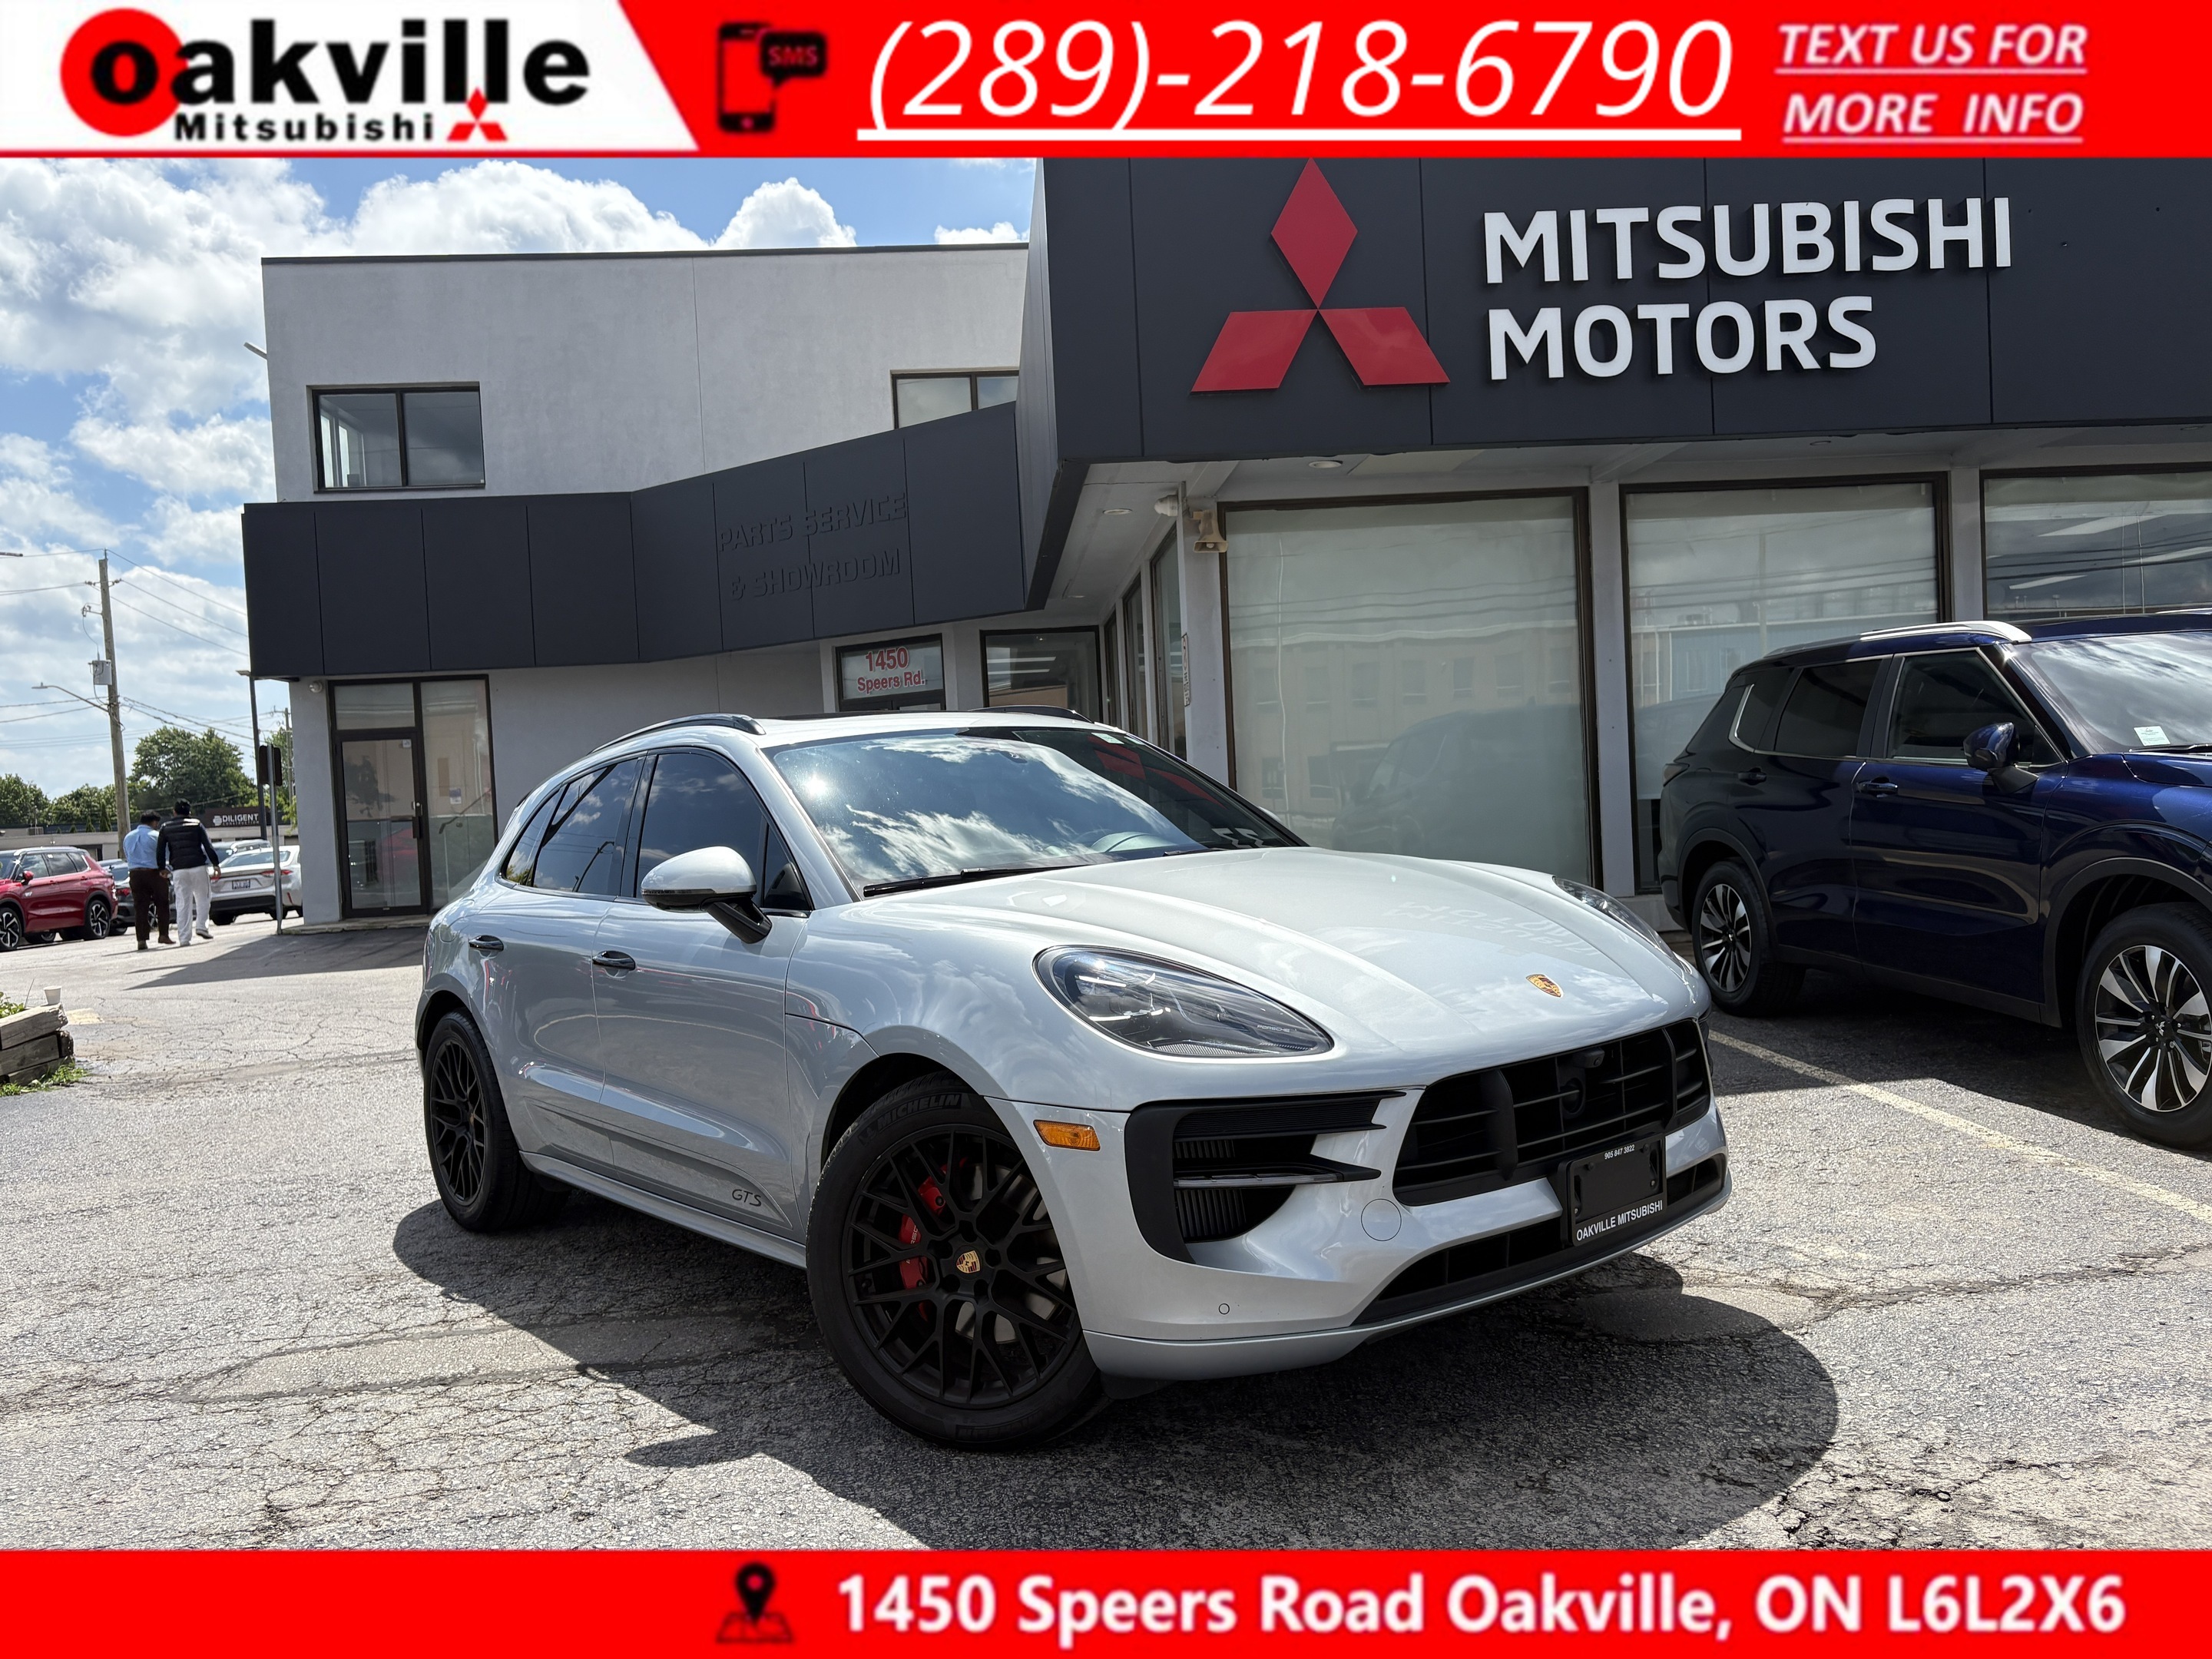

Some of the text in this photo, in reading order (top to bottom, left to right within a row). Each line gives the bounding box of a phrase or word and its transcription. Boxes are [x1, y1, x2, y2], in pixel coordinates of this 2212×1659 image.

[1484, 197, 2012, 284] MITSUBISHI
[1488, 296, 1876, 380] MOTORS
[720, 493, 906, 551] PARTS SERVICE
[732, 548, 900, 601] & SHOWROOM
[866, 647, 909, 672] 1450
[857, 670, 926, 694] Speers Rd.
[222, 813, 259, 823] DILIGENT
[877, 1094, 960, 1131] MICHELIN
[1604, 1151, 1614, 1160] 905
[732, 1189, 762, 1207] GTS
[1576, 1200, 1663, 1241] OAKVILLE MITSUBISHI
